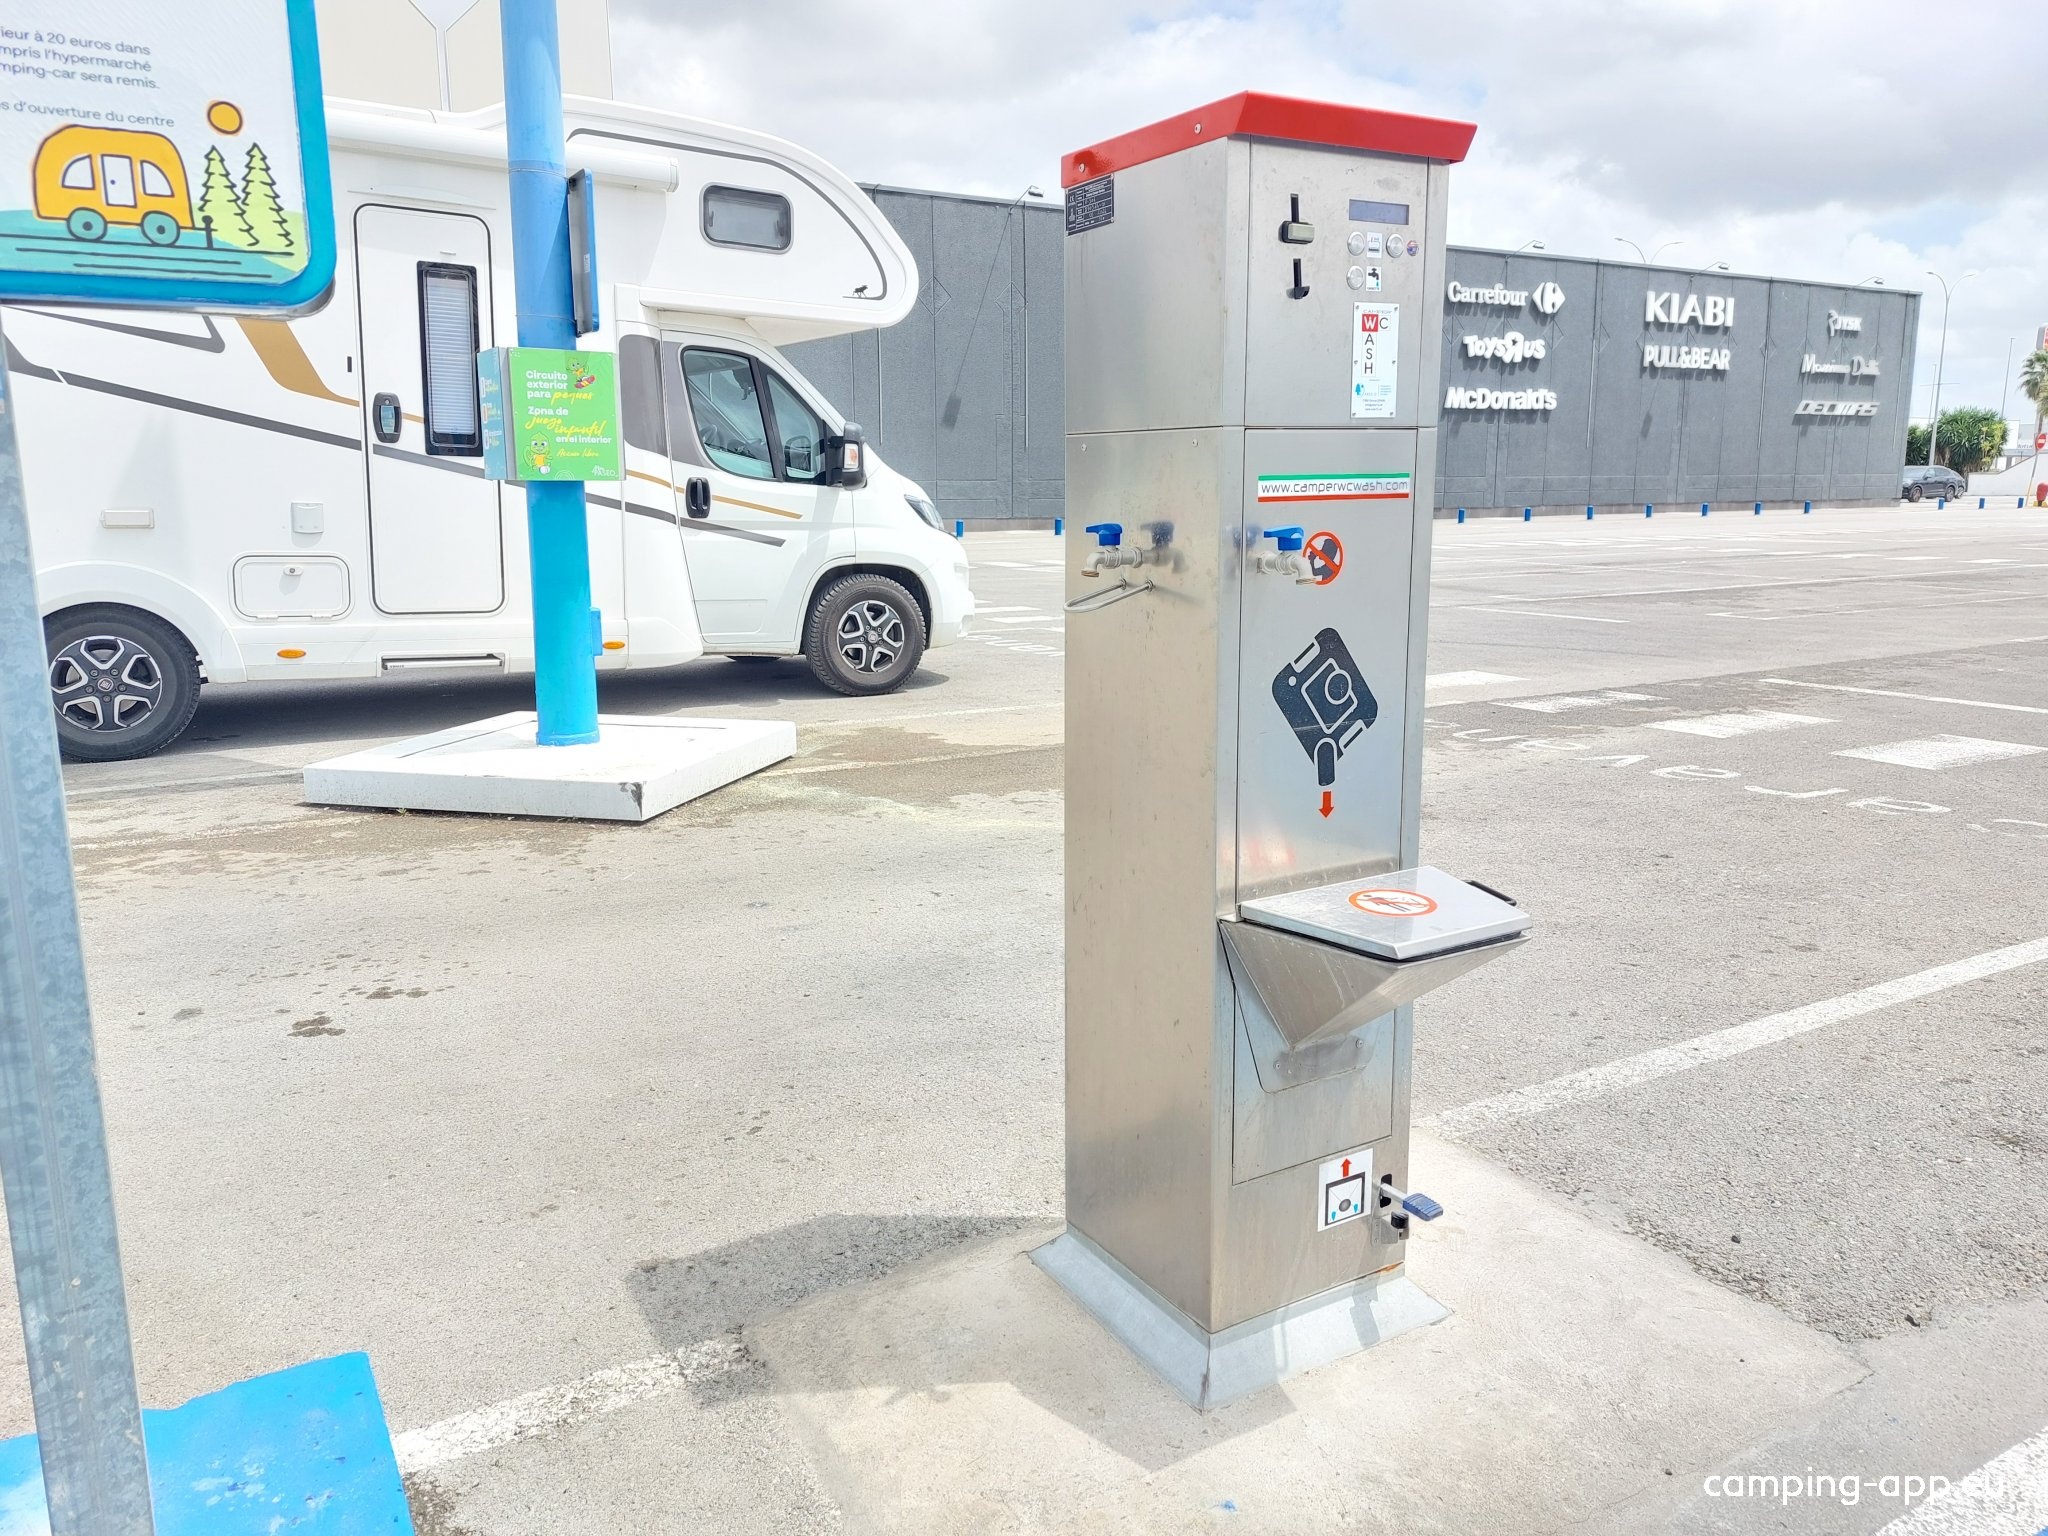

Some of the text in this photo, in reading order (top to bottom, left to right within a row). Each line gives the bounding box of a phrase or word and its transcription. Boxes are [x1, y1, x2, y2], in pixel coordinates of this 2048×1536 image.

[34, 30, 44, 42] à
[47, 32, 65, 45] 20
[70, 37, 111, 51] euros
[115, 41, 151, 56] dans
[80, 71, 113, 84] sera
[117, 75, 160, 90] remis.
[14, 100, 102, 120] d'ouverture
[105, 110, 124, 122] du
[127, 113, 175, 128] centre
[1448, 281, 1529, 306] Carrefour
[1645, 290, 1735, 327] KIABI
[1643, 344, 1731, 371] PULL&BEAR
[526, 370, 568, 380] Circuito
[526, 381, 568, 389] exterior
[527, 390, 593, 405] para peques
[1444, 387, 1558, 410] McDonald's
[528, 406, 568, 415] Zona de
[1794, 400, 1881, 417] DECIMAS
[525, 415, 562, 430] juego
[555, 420, 607, 436] infantil
[556, 435, 612, 444] en el interior
[1261, 480, 1408, 493] www.camperwcwash.com
